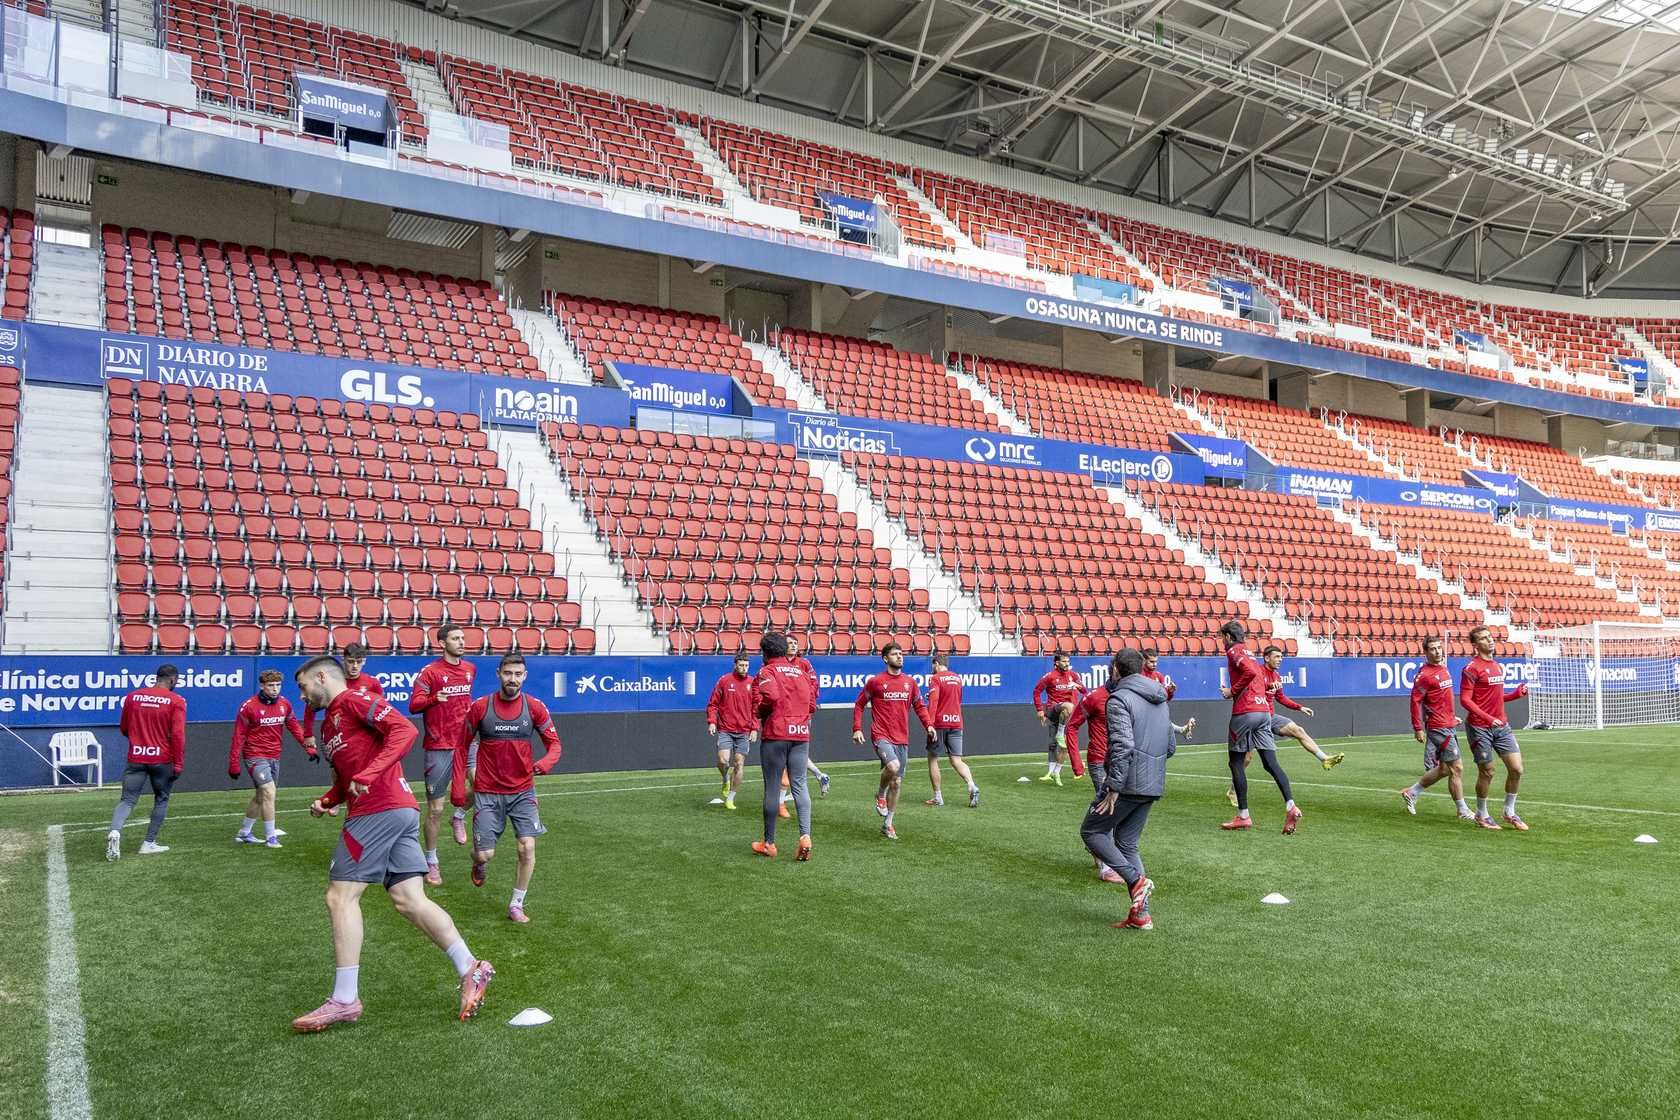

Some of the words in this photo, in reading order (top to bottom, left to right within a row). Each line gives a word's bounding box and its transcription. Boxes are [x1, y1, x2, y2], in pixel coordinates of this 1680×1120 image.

[1025, 298, 1101, 325] OSASUNA
[1105, 312, 1157, 335] NUNCA
[1160, 322, 1178, 339] SE
[1180, 325, 1222, 347] RINDE
[106, 345, 143, 366] DN
[158, 344, 235, 368] DIARIO
[238, 353, 268, 372] DE
[158, 366, 269, 394] NAVARRA
[495, 408, 577, 424] PLATAFORMAS
[805, 416, 827, 426] Diario
[827, 418, 836, 427] de
[803, 426, 886, 454] Noticias
[999, 441, 1035, 460] mrc
[0, 669, 79, 690] línica
[85, 669, 243, 689] Univesidad
[1375, 662, 1424, 690] DIG
[1500, 662, 1541, 682] osner
[599, 675, 677, 692] CaixaBank
[0, 697, 16, 712] e
[132, 694, 171, 705] macron
[132, 745, 161, 756] DIGI
